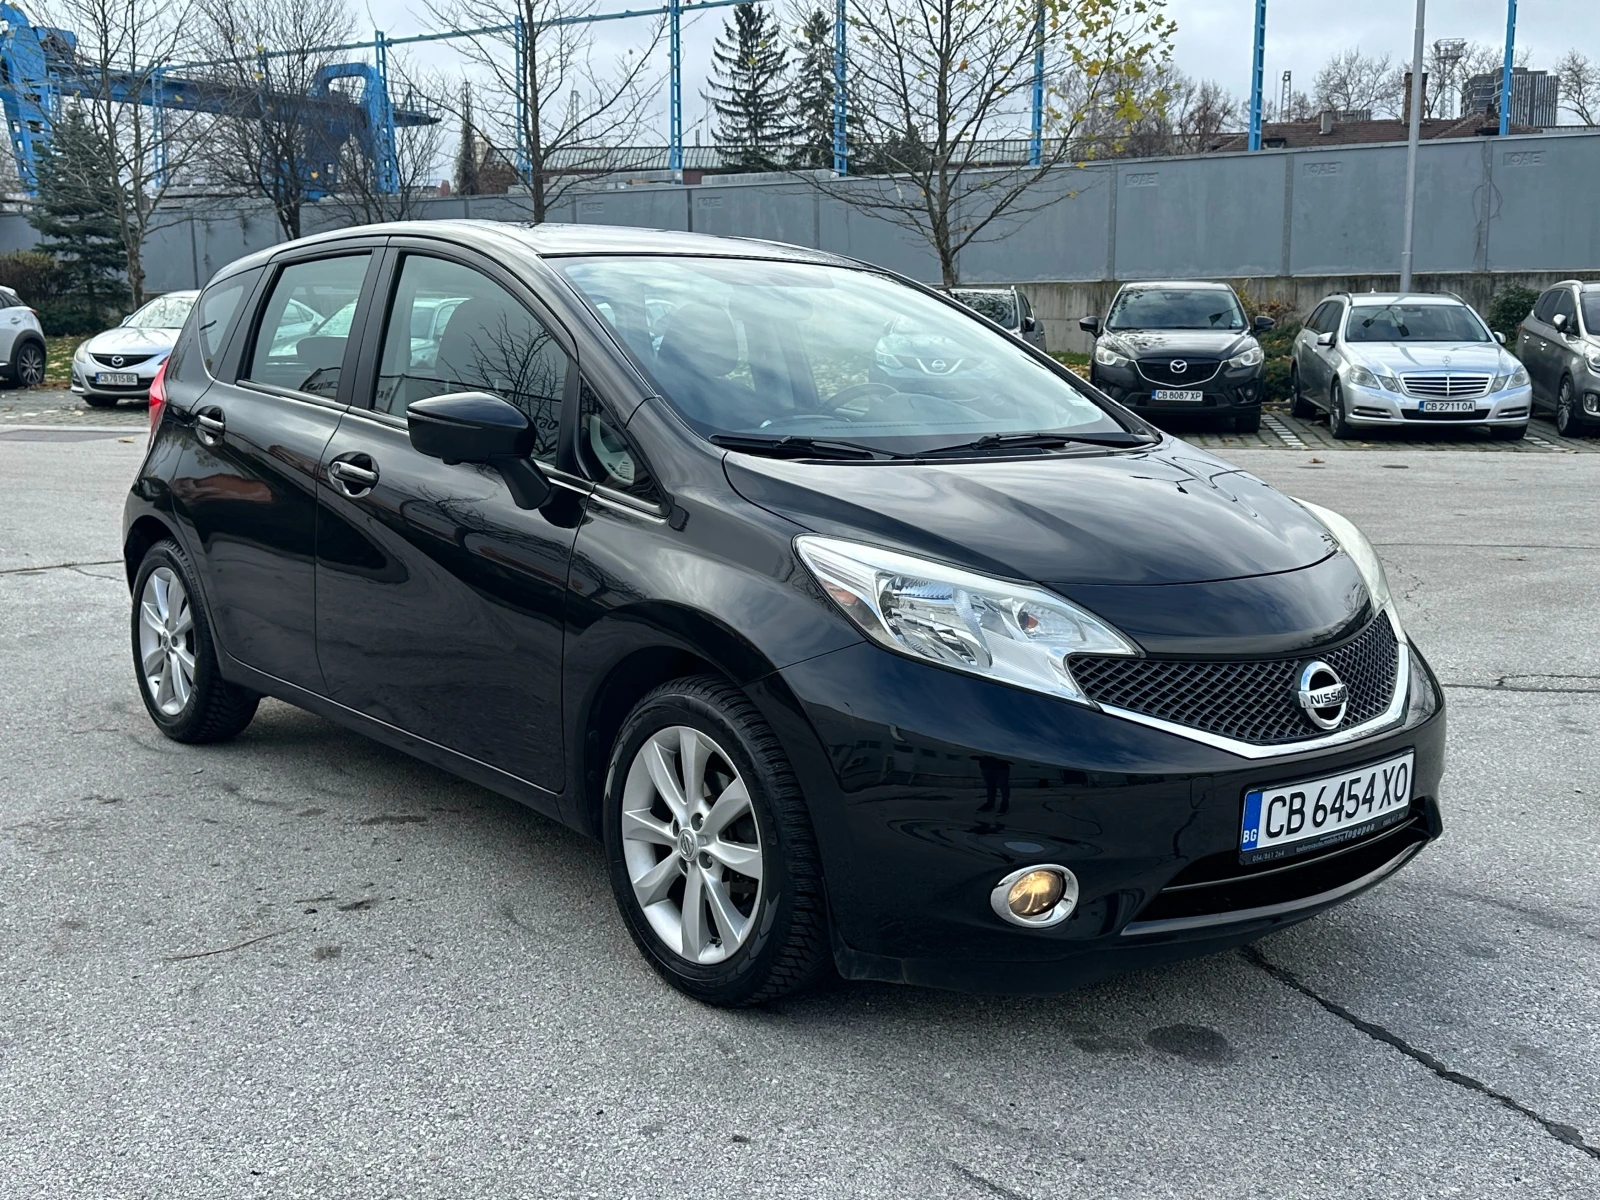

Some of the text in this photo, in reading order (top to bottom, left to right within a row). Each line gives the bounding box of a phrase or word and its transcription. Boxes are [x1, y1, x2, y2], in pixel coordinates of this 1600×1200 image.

[109, 374, 126, 383] 7015
[1157, 390, 1201, 400] CB 8087 XP
[1425, 402, 1438, 411] CB
[1439, 402, 1460, 411] 2711
[1310, 685, 1347, 704] NISSAN
[1266, 762, 1408, 838] CB 6454 XO
[1243, 828, 1258, 843] BG
